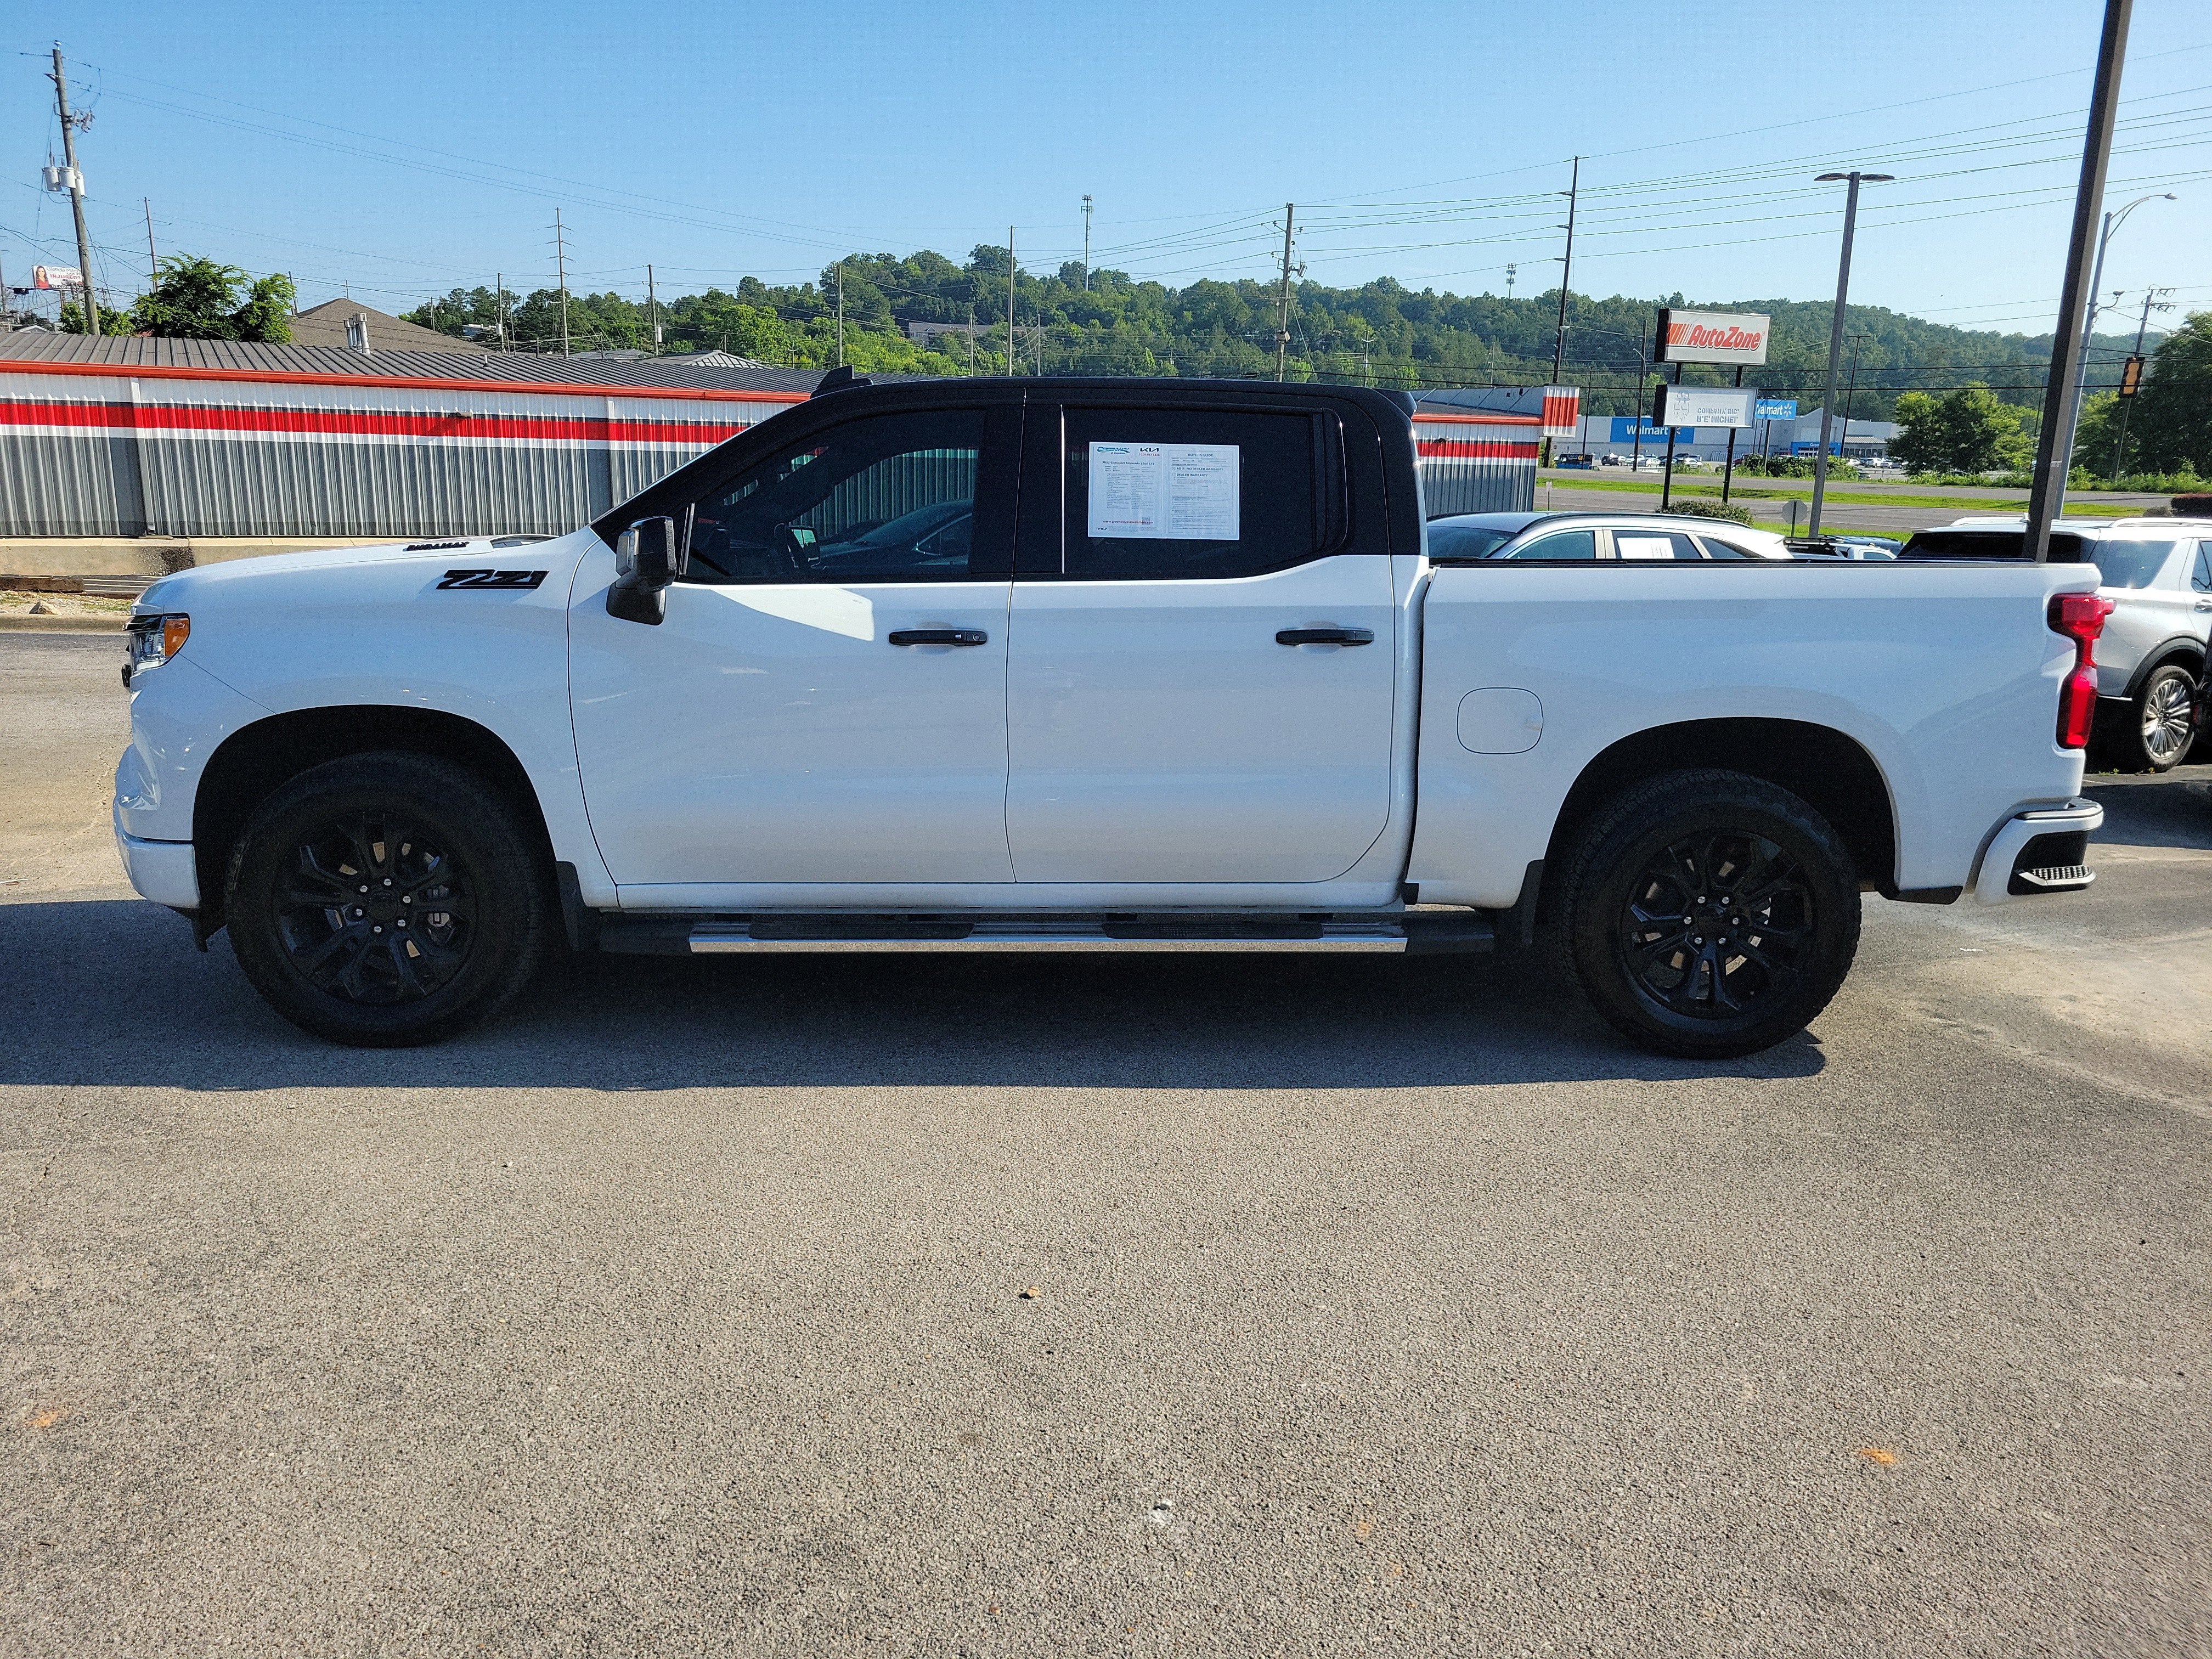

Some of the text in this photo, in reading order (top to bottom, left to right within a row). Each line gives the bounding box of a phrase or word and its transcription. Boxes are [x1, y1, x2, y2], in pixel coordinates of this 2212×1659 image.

[1687, 324, 1762, 350] AutoZone
[407, 541, 470, 551] DURAMAX
[436, 569, 550, 590] Z71
